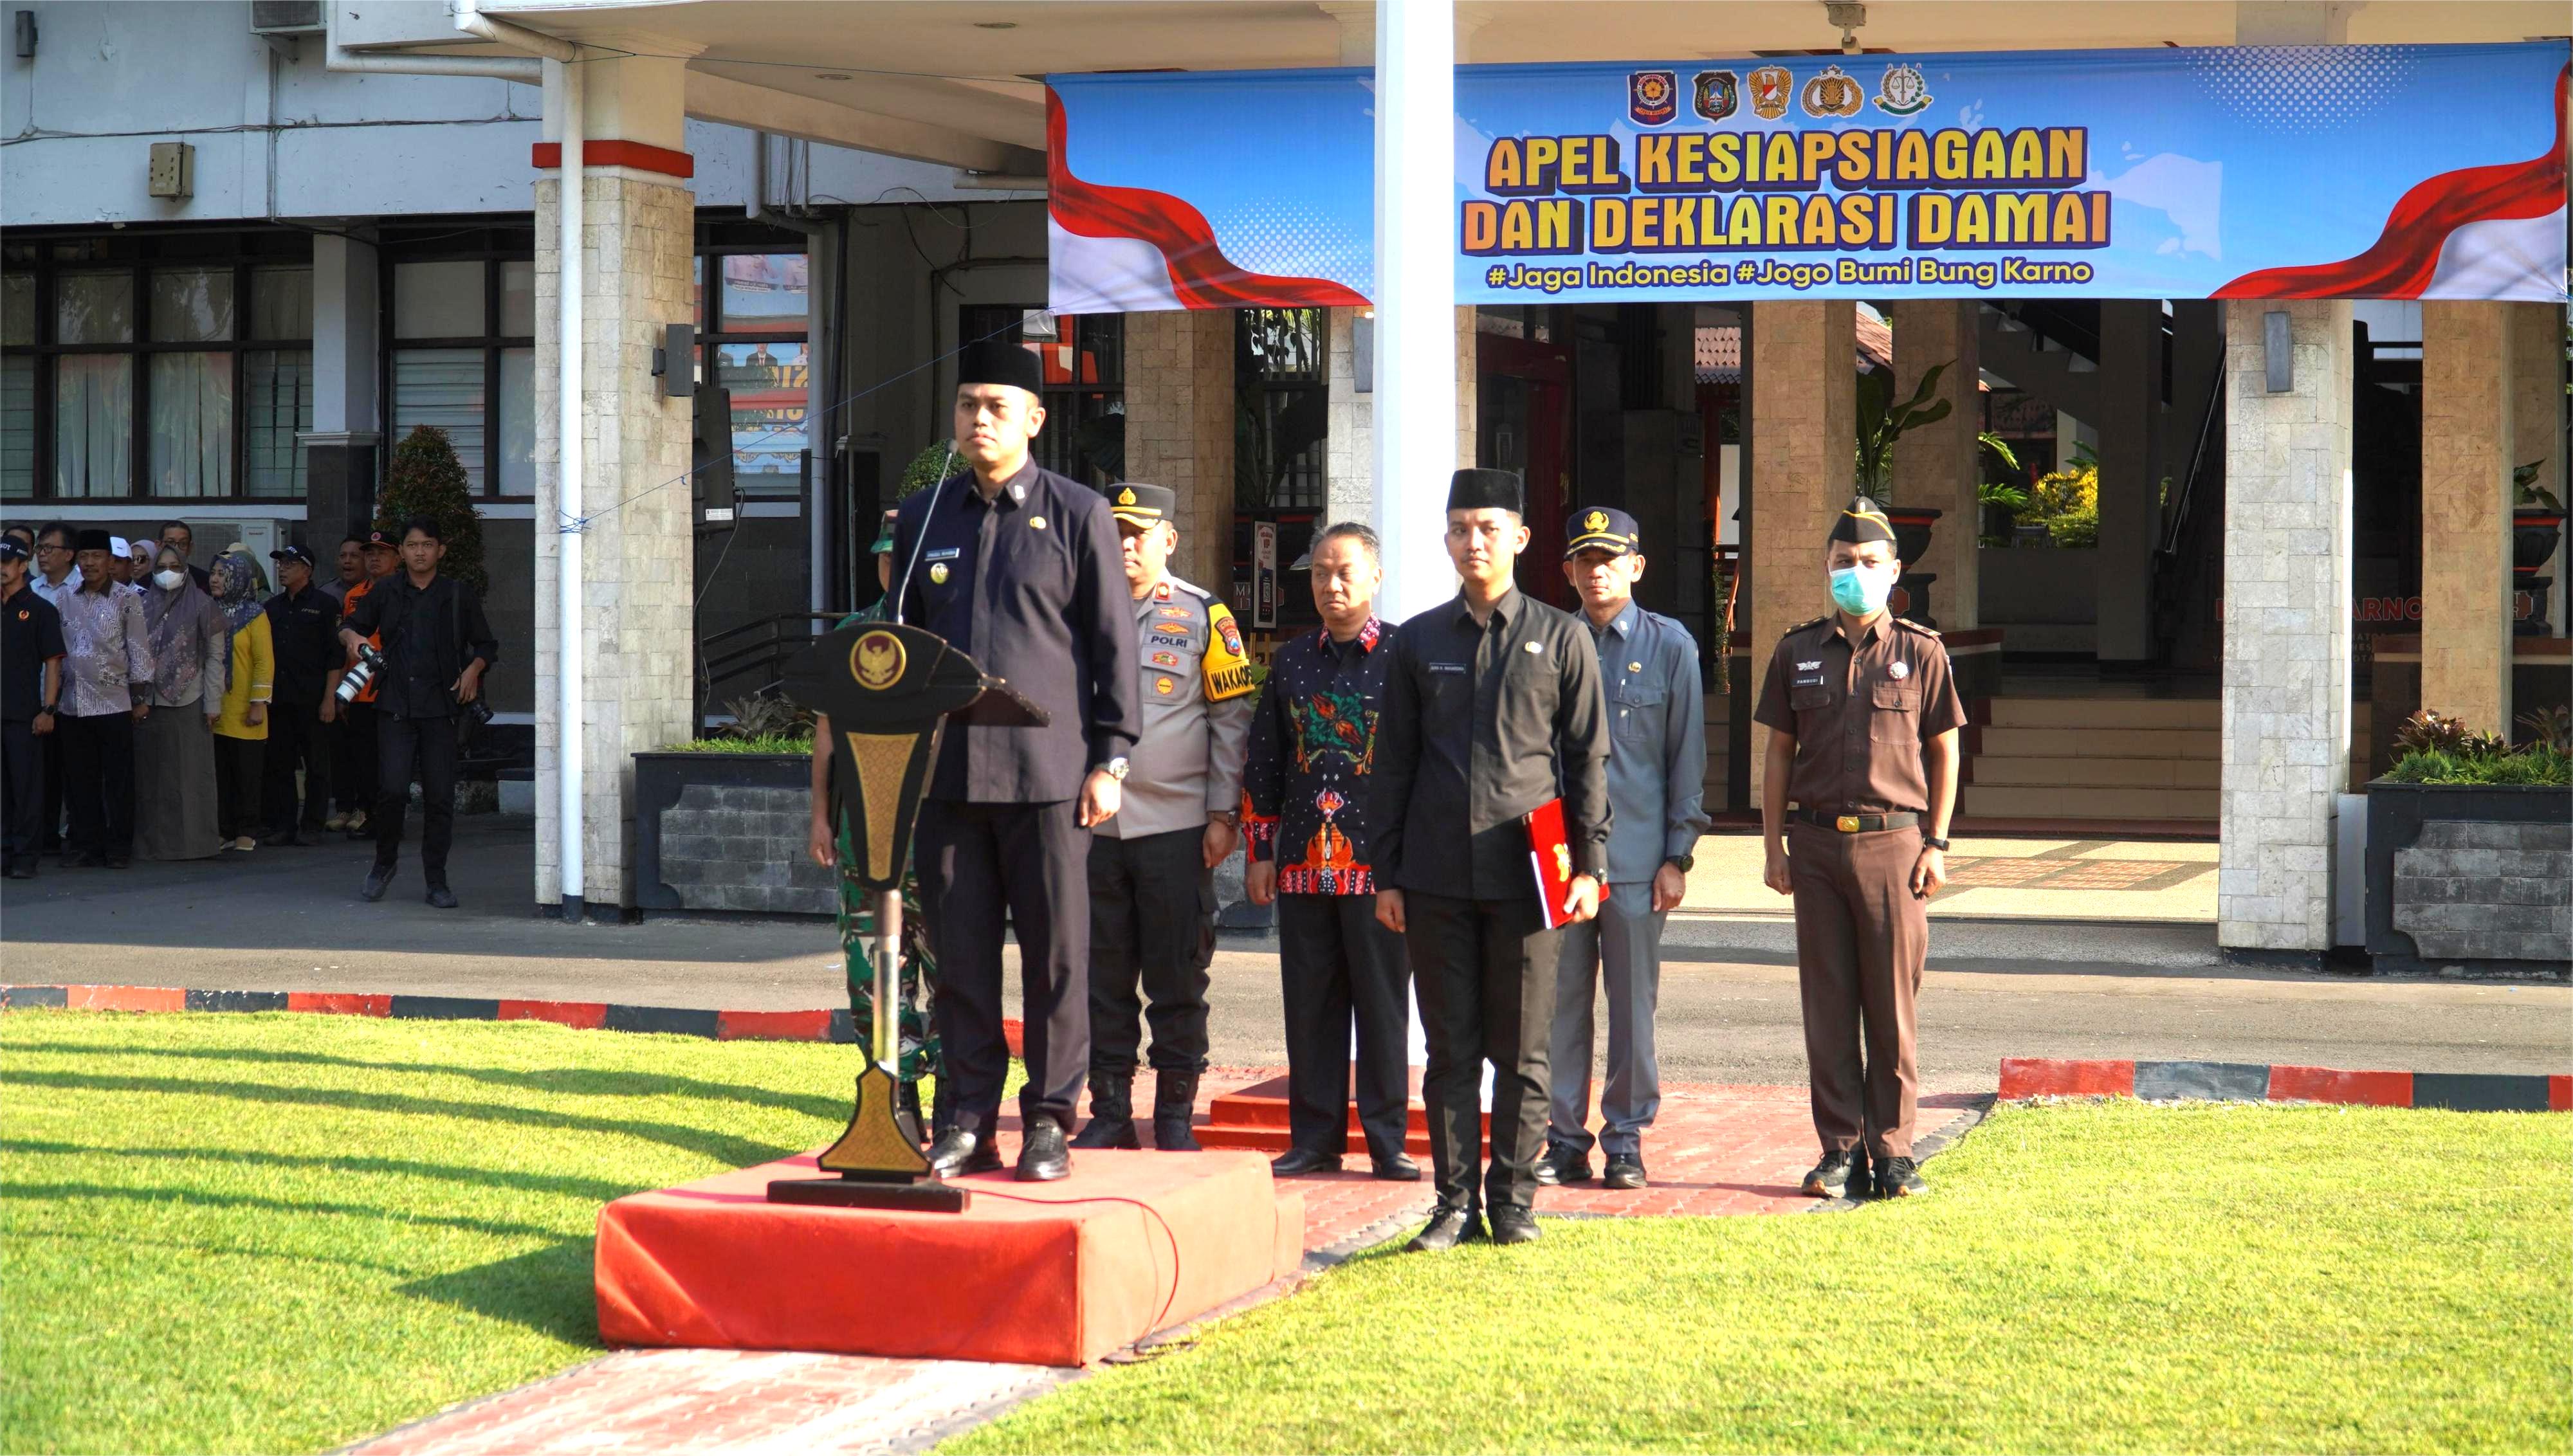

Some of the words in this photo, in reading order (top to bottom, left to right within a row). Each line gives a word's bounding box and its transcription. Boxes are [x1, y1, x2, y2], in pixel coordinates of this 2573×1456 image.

[1488, 136, 1620, 187] APEL
[1638, 129, 2085, 185] KESIAPSIAGAAN
[1463, 199, 1571, 251] DAN
[1592, 194, 1894, 248] DEKLARASI
[1917, 192, 2107, 244] DAMAI
[1488, 267, 1581, 292] #Jaga
[1588, 264, 1728, 286] Indonesia
[1737, 262, 1831, 288] #Jogo
[1838, 260, 1911, 282] Bumi
[1919, 260, 1995, 287] Bung
[2003, 260, 2091, 282] Karno
[2352, 597, 2422, 621] ARNO
[1151, 635, 1188, 648] POLRI
